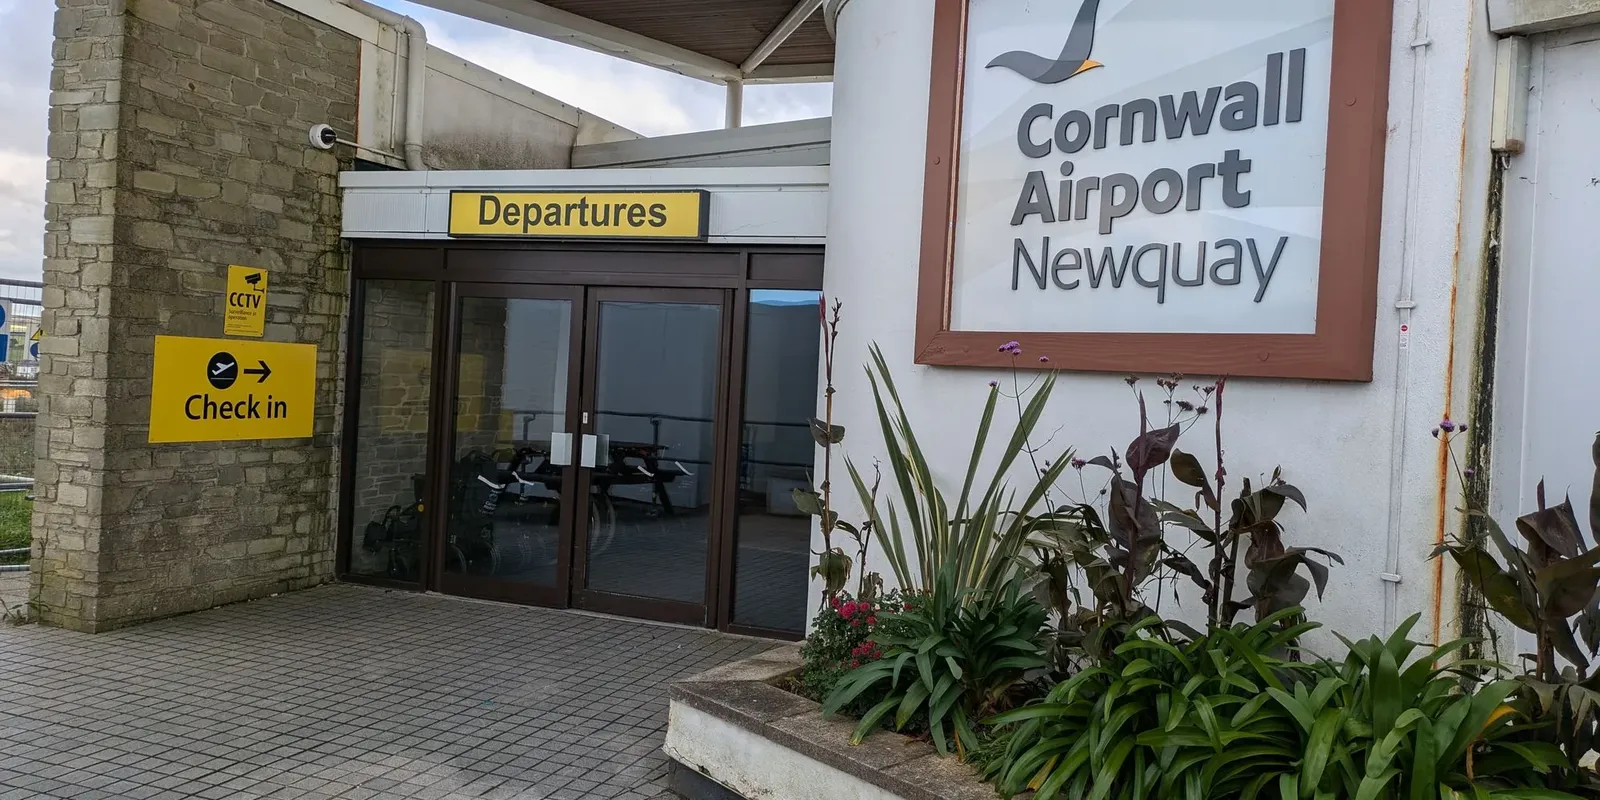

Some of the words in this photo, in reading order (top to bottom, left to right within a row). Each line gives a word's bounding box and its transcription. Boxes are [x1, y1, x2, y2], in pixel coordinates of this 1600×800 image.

[1017, 47, 1306, 158] Cornwall
[478, 195, 668, 234] Departures
[1010, 149, 1252, 234] Airport
[1011, 236, 1289, 304] Newquay
[229, 292, 261, 308] CCTV
[185, 394, 260, 420] Check
[267, 395, 287, 419] in
